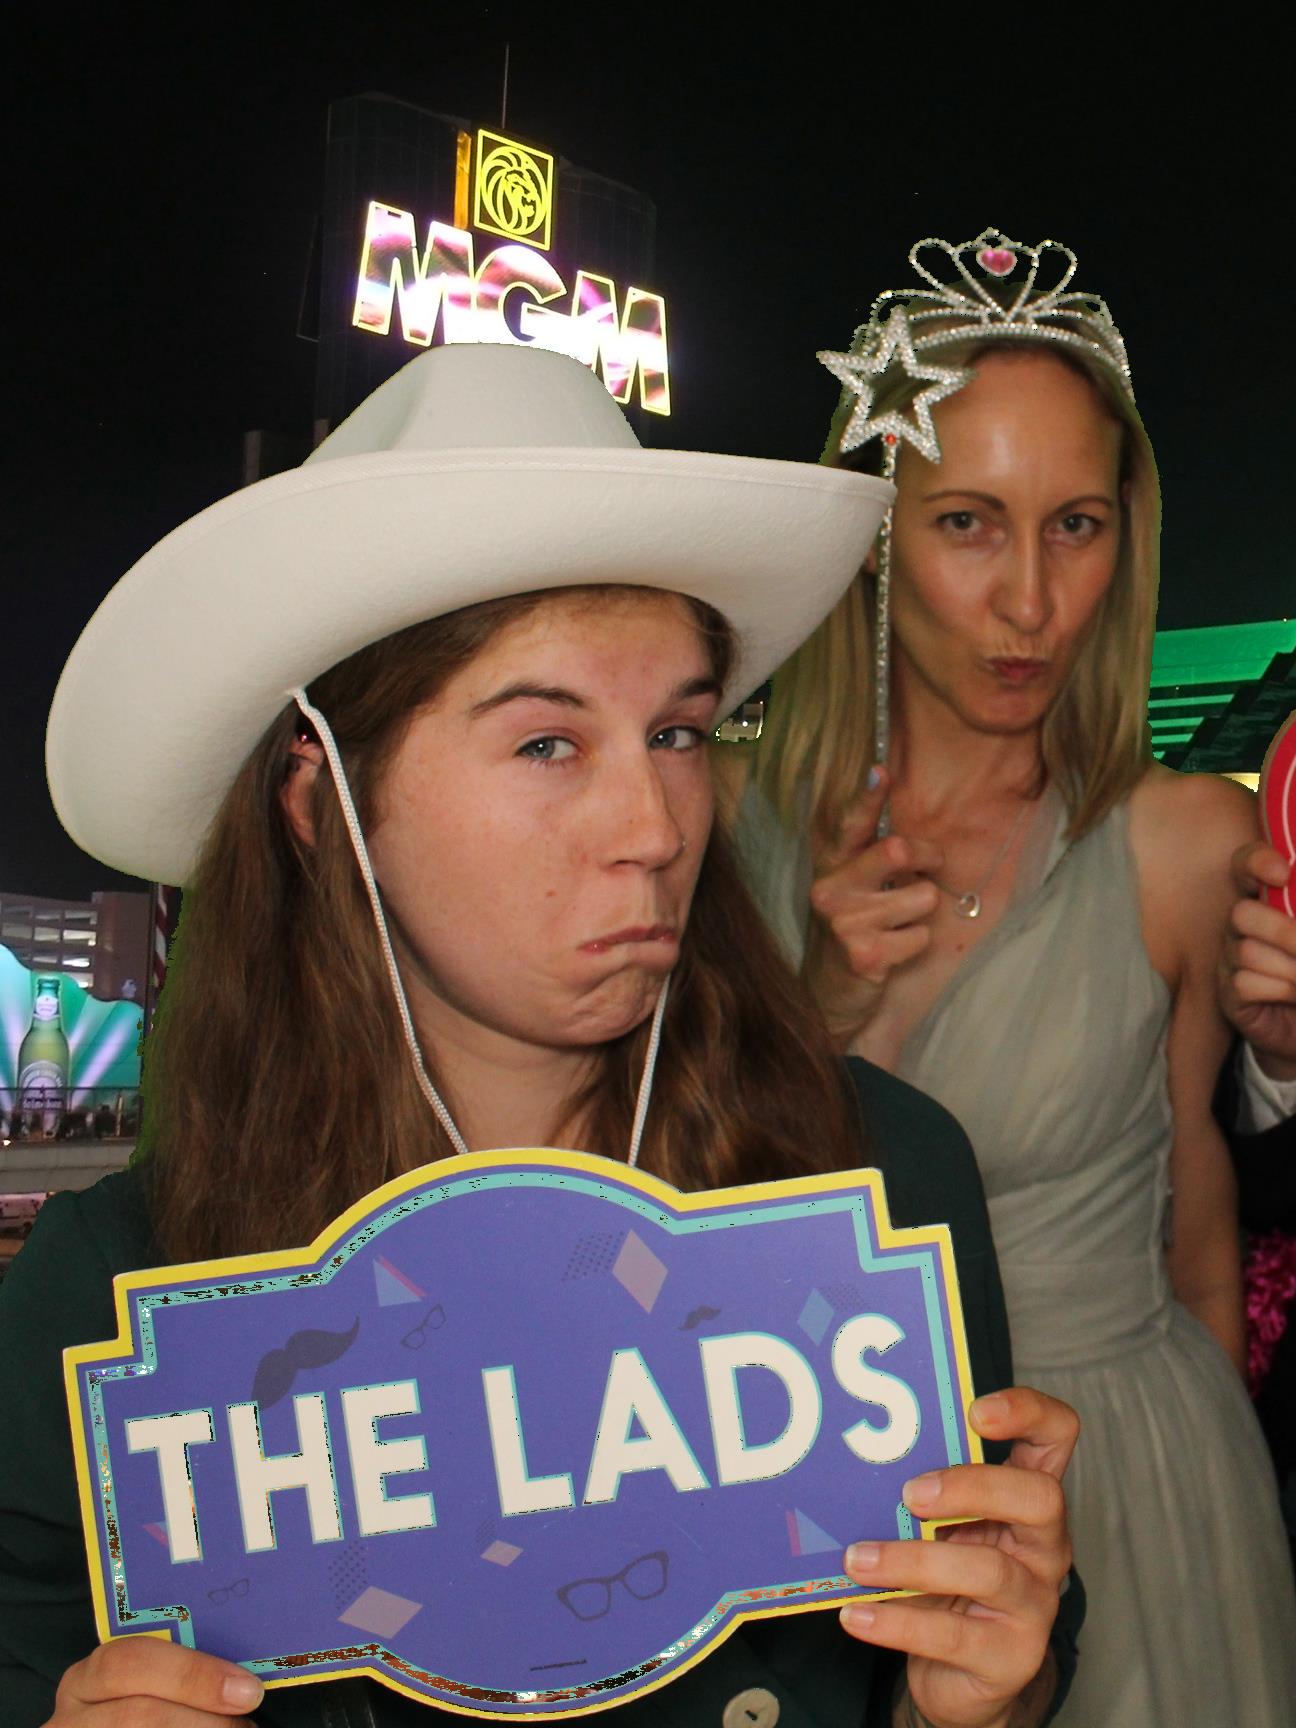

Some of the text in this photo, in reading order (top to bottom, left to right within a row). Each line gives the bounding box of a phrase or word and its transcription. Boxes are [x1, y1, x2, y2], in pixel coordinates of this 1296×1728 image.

[352, 200, 671, 416] MGM
[125, 1313, 922, 1563] THE LADS
